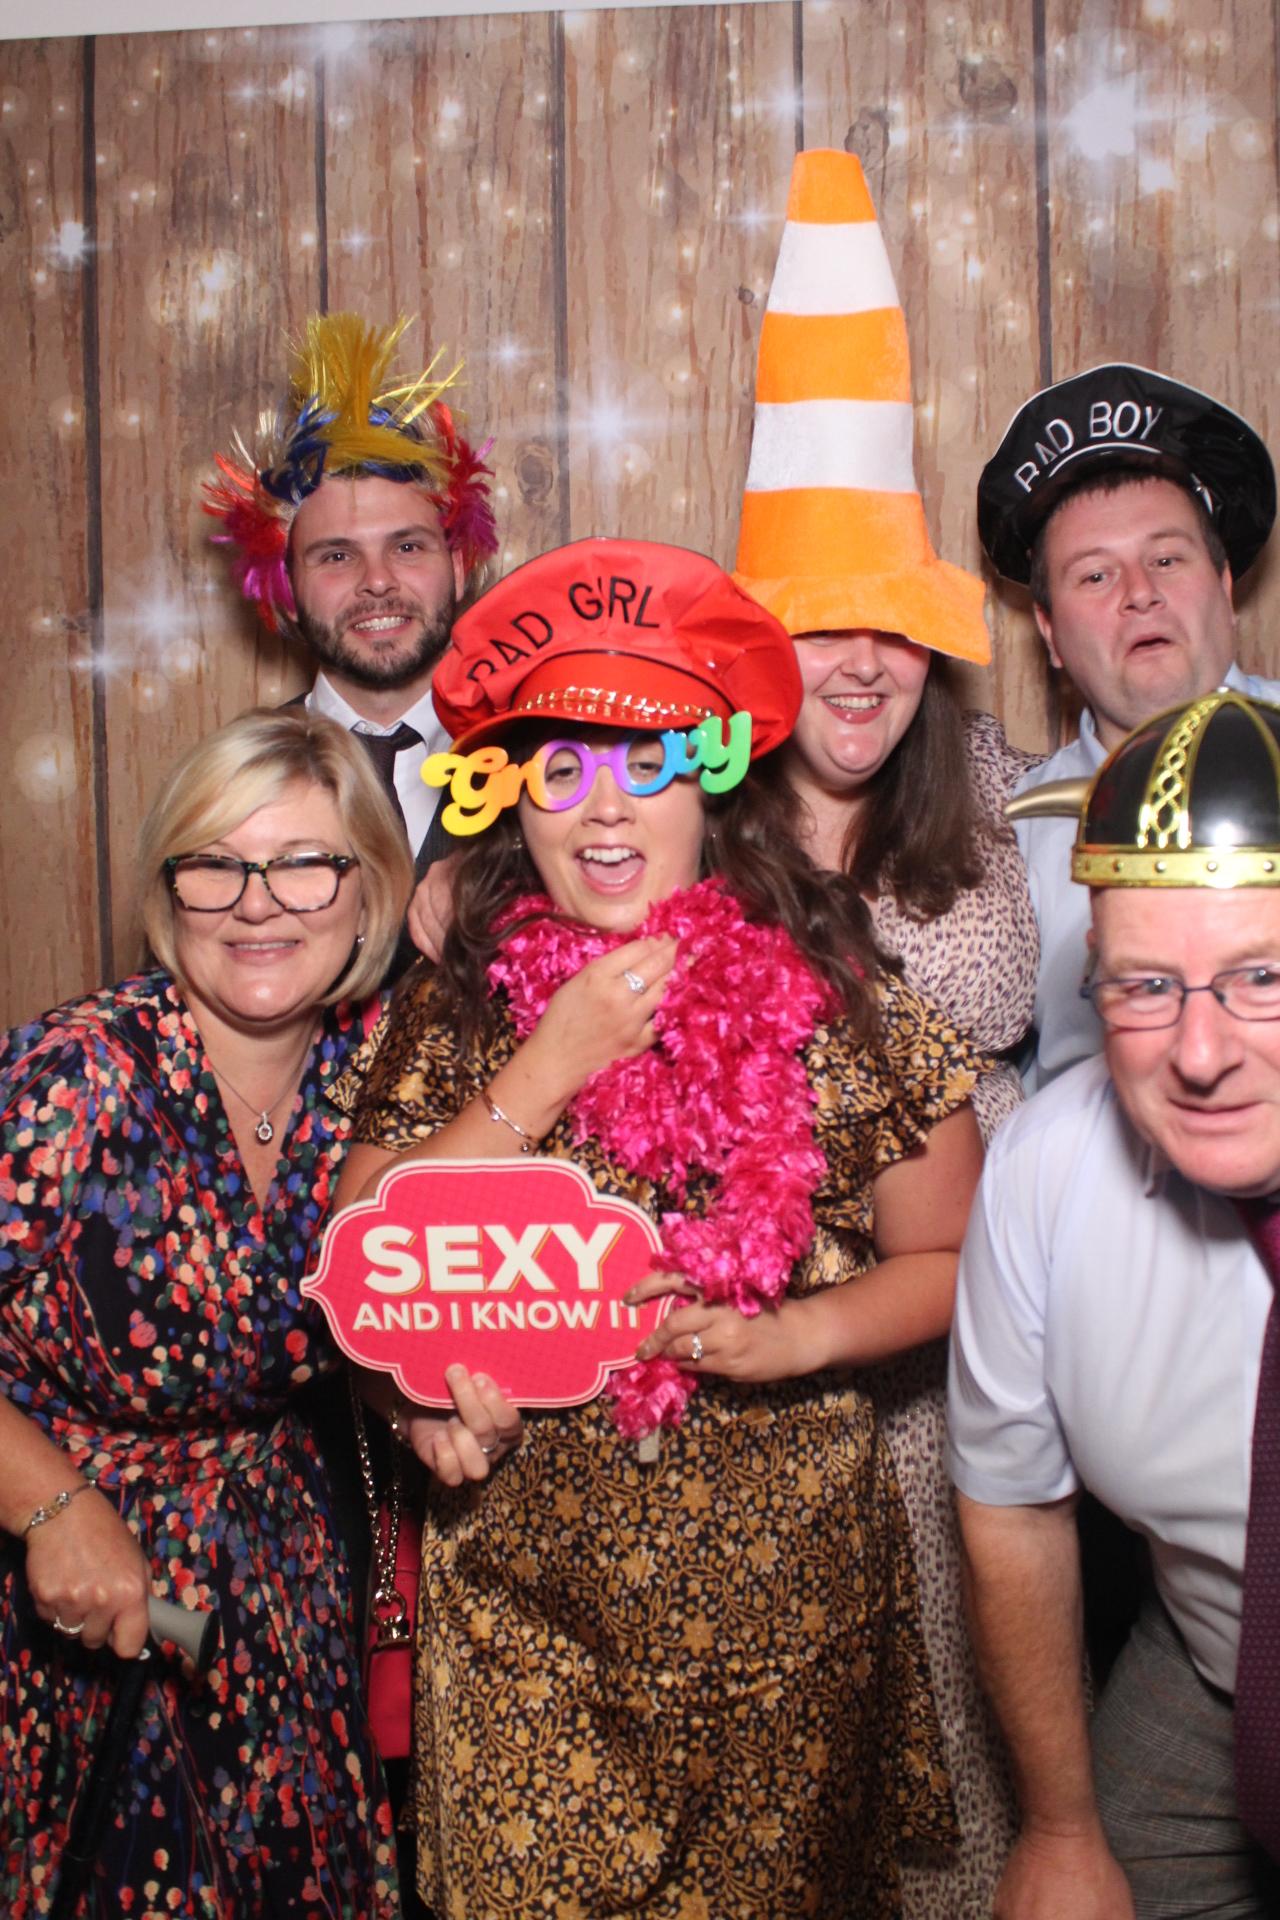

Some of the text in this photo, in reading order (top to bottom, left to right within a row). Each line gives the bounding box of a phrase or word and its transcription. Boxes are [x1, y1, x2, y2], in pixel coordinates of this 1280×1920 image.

[1089, 401, 1163, 440] BOY
[361, 1222, 625, 1292] SEXY
[352, 1300, 648, 1331] AND I KNOW IT
